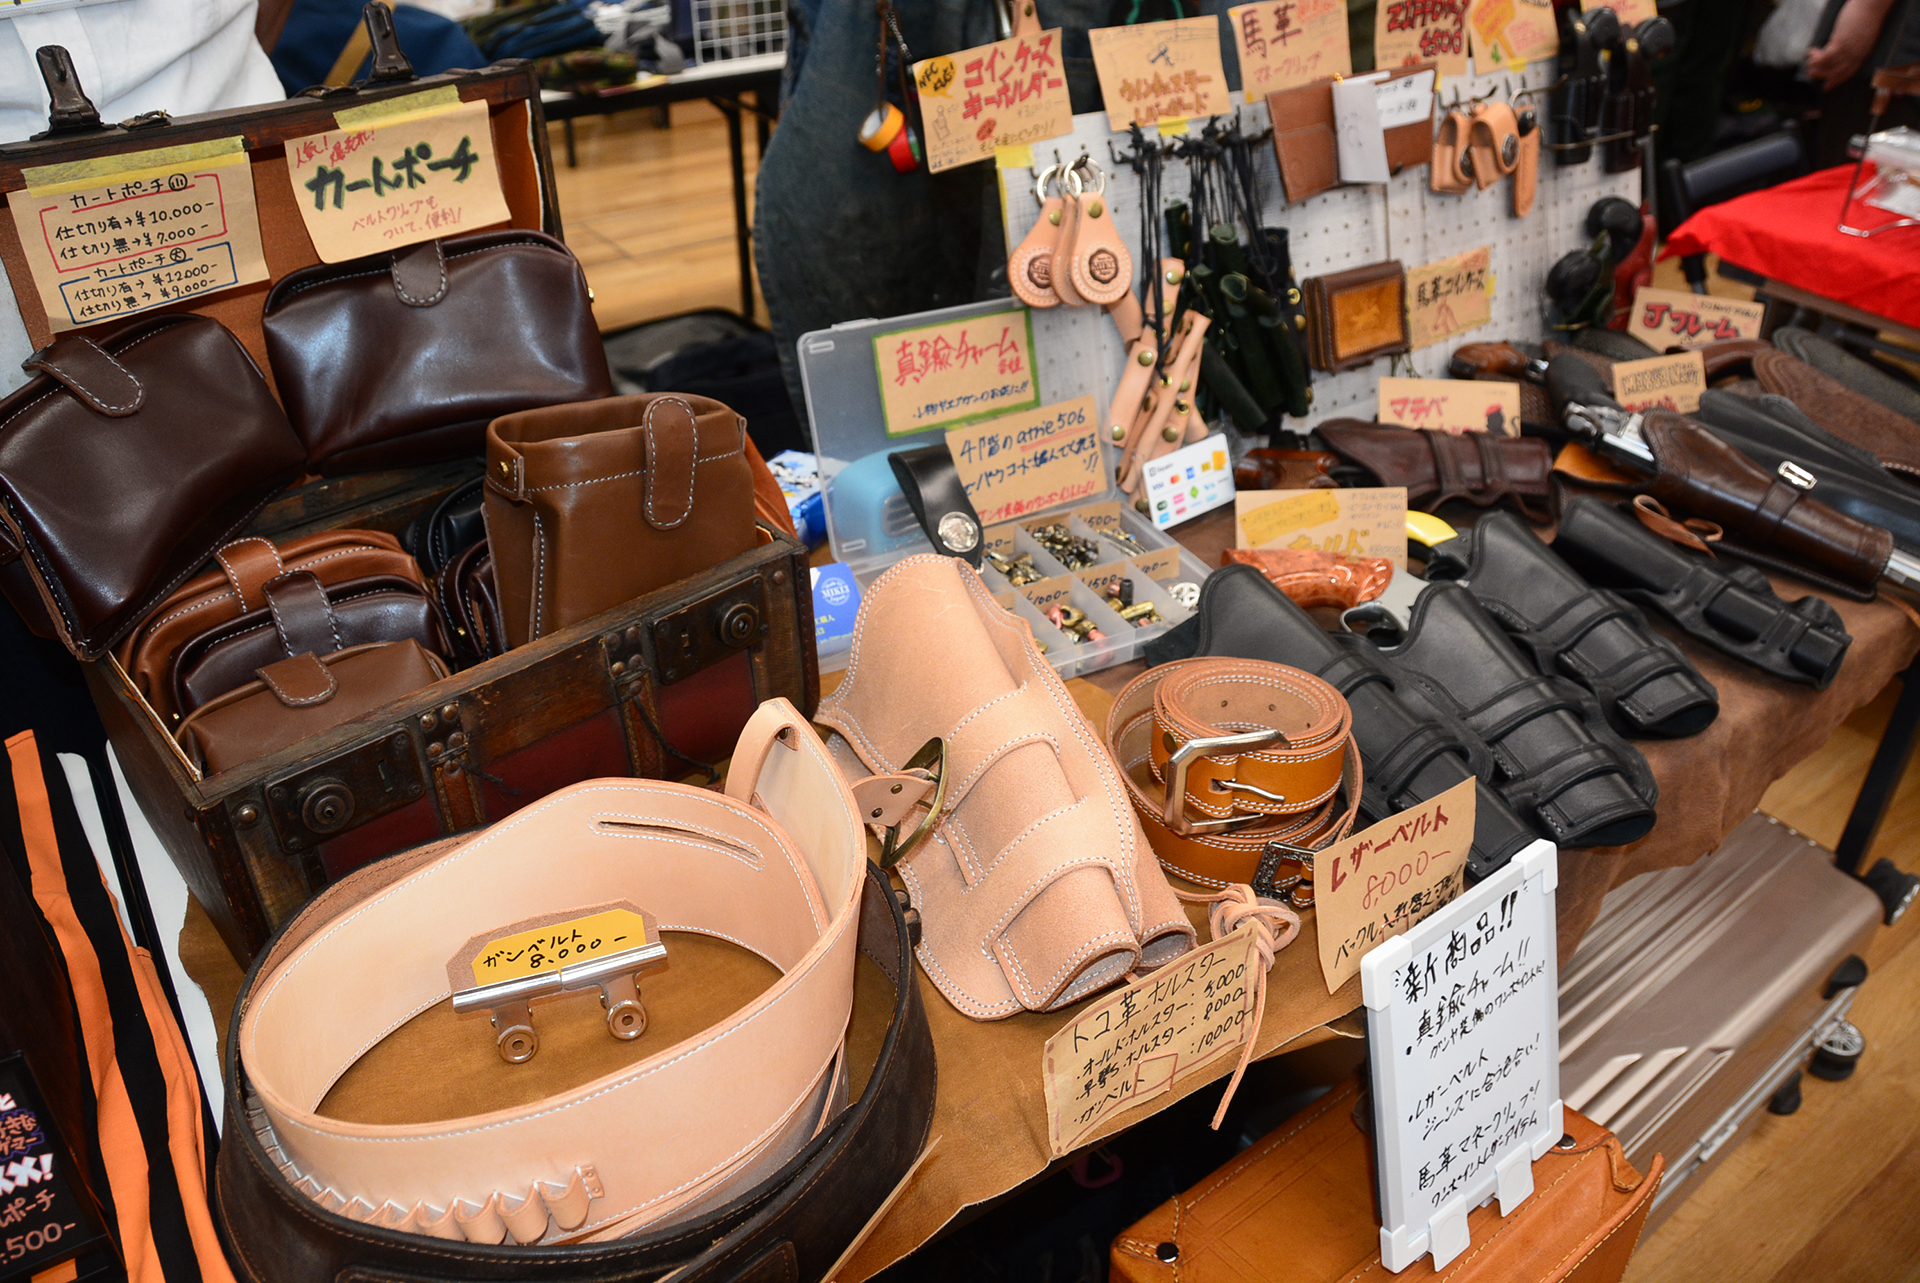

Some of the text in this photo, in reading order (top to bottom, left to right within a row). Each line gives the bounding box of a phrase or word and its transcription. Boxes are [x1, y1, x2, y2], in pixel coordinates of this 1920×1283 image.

[963, 34, 1054, 88] コインケース
[963, 70, 1062, 119] キーホルダー
[70, 178, 164, 209] カートポーチ
[304, 134, 480, 212] カートポーチ
[94, 252, 166, 278] カートポーチ
[895, 326, 1020, 387] 真鍮チャーム
[1331, 805, 1449, 893] レザーベルト
[483, 929, 583, 968] ガンベルト
[1402, 889, 1519, 1005] 新商品!!
